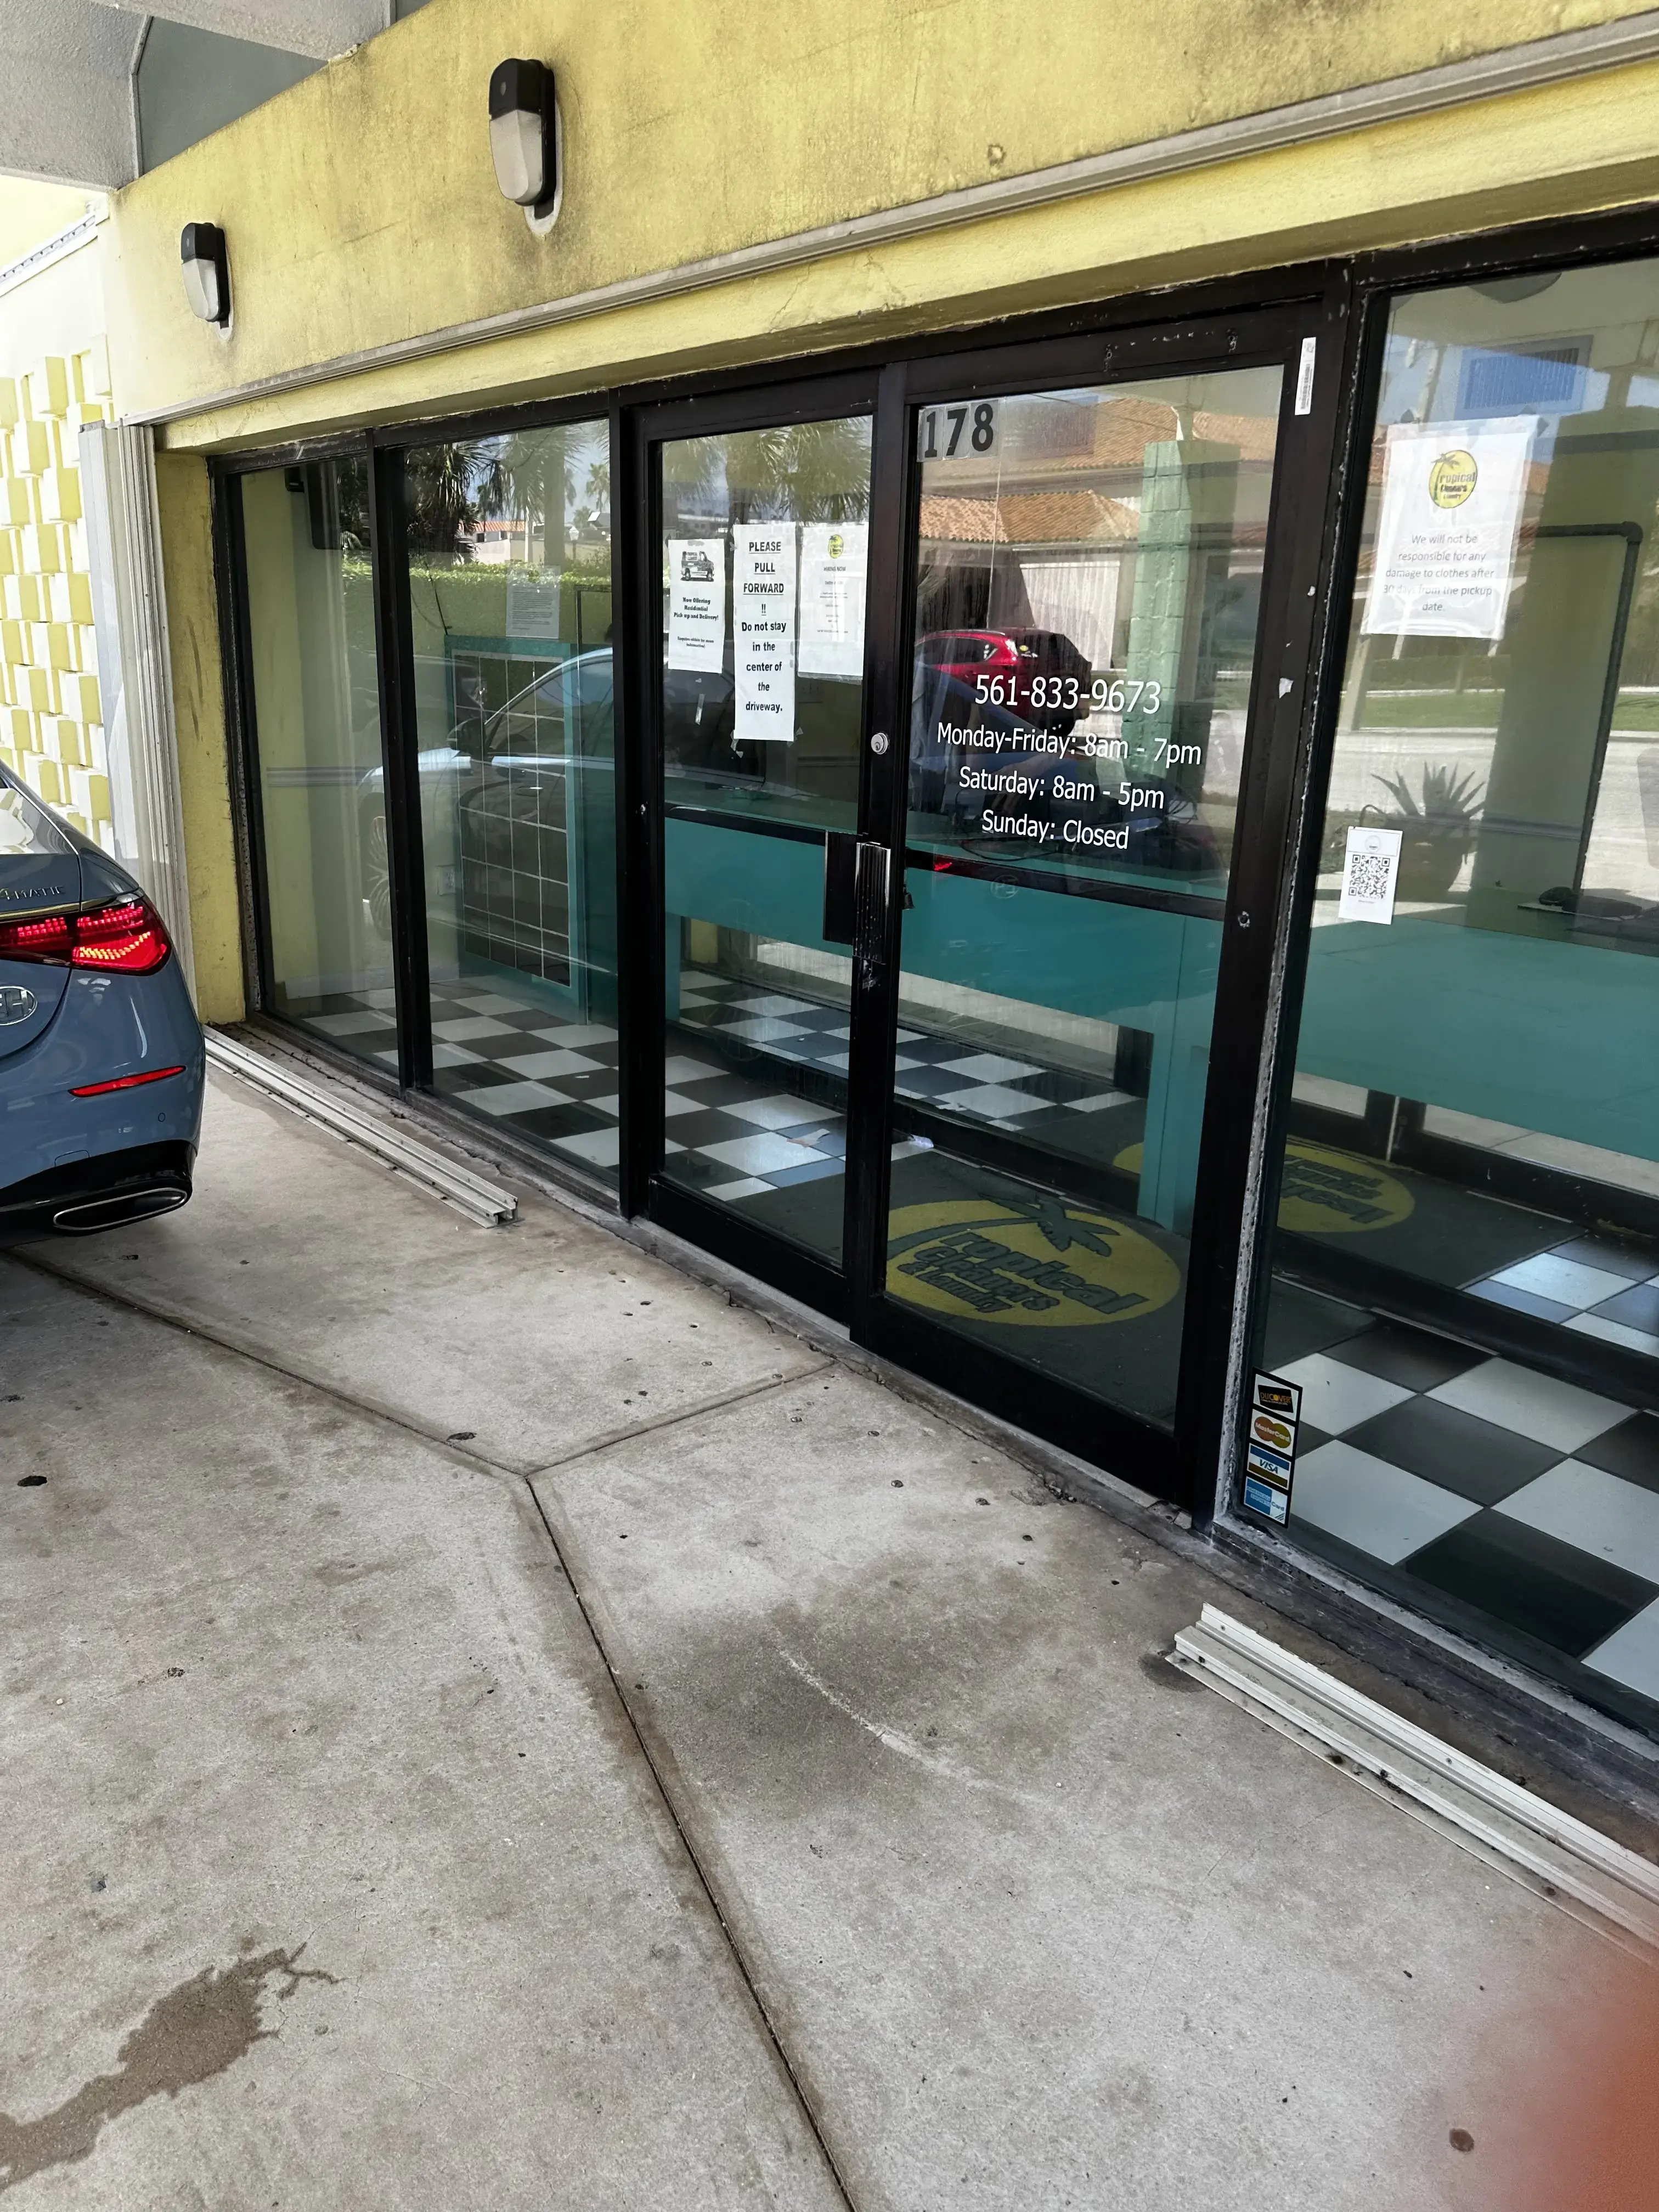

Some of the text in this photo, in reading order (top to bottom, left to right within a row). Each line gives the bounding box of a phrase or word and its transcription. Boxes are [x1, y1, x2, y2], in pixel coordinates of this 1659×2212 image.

[924, 403, 994, 458] 178
[1412, 534, 1478, 544] We will not be
[748, 541, 781, 552] PLEASE
[1398, 551, 1486, 563] responsible for any
[754, 562, 775, 572] PULL
[1386, 568, 1495, 579] damage to clothes after
[743, 583, 784, 593] FORWARD
[1443, 586, 1458, 595] the
[1460, 585, 1492, 597] pickup
[1422, 603, 1446, 611] date.
[741, 621, 787, 633] Do not stay
[752, 641, 776, 652] in the
[746, 661, 782, 672] center of
[758, 682, 770, 691] the
[974, 674, 1161, 714] 561-833-9673
[746, 701, 783, 714] driveway.
[937, 721, 1076, 759] Monday-Friday:
[1084, 733, 1128, 759] 8am
[1153, 737, 1201, 769] 7pm
[959, 766, 1045, 801] Saturday:
[1053, 775, 1094, 802] 8am
[1118, 781, 1164, 812] 5pm
[981, 809, 1130, 850] Sunday: Closed
[1255, 1422, 1290, 1442] MasterCard
[1259, 1458, 1278, 1475] VISA
[1271, 1502, 1284, 1511] Card
